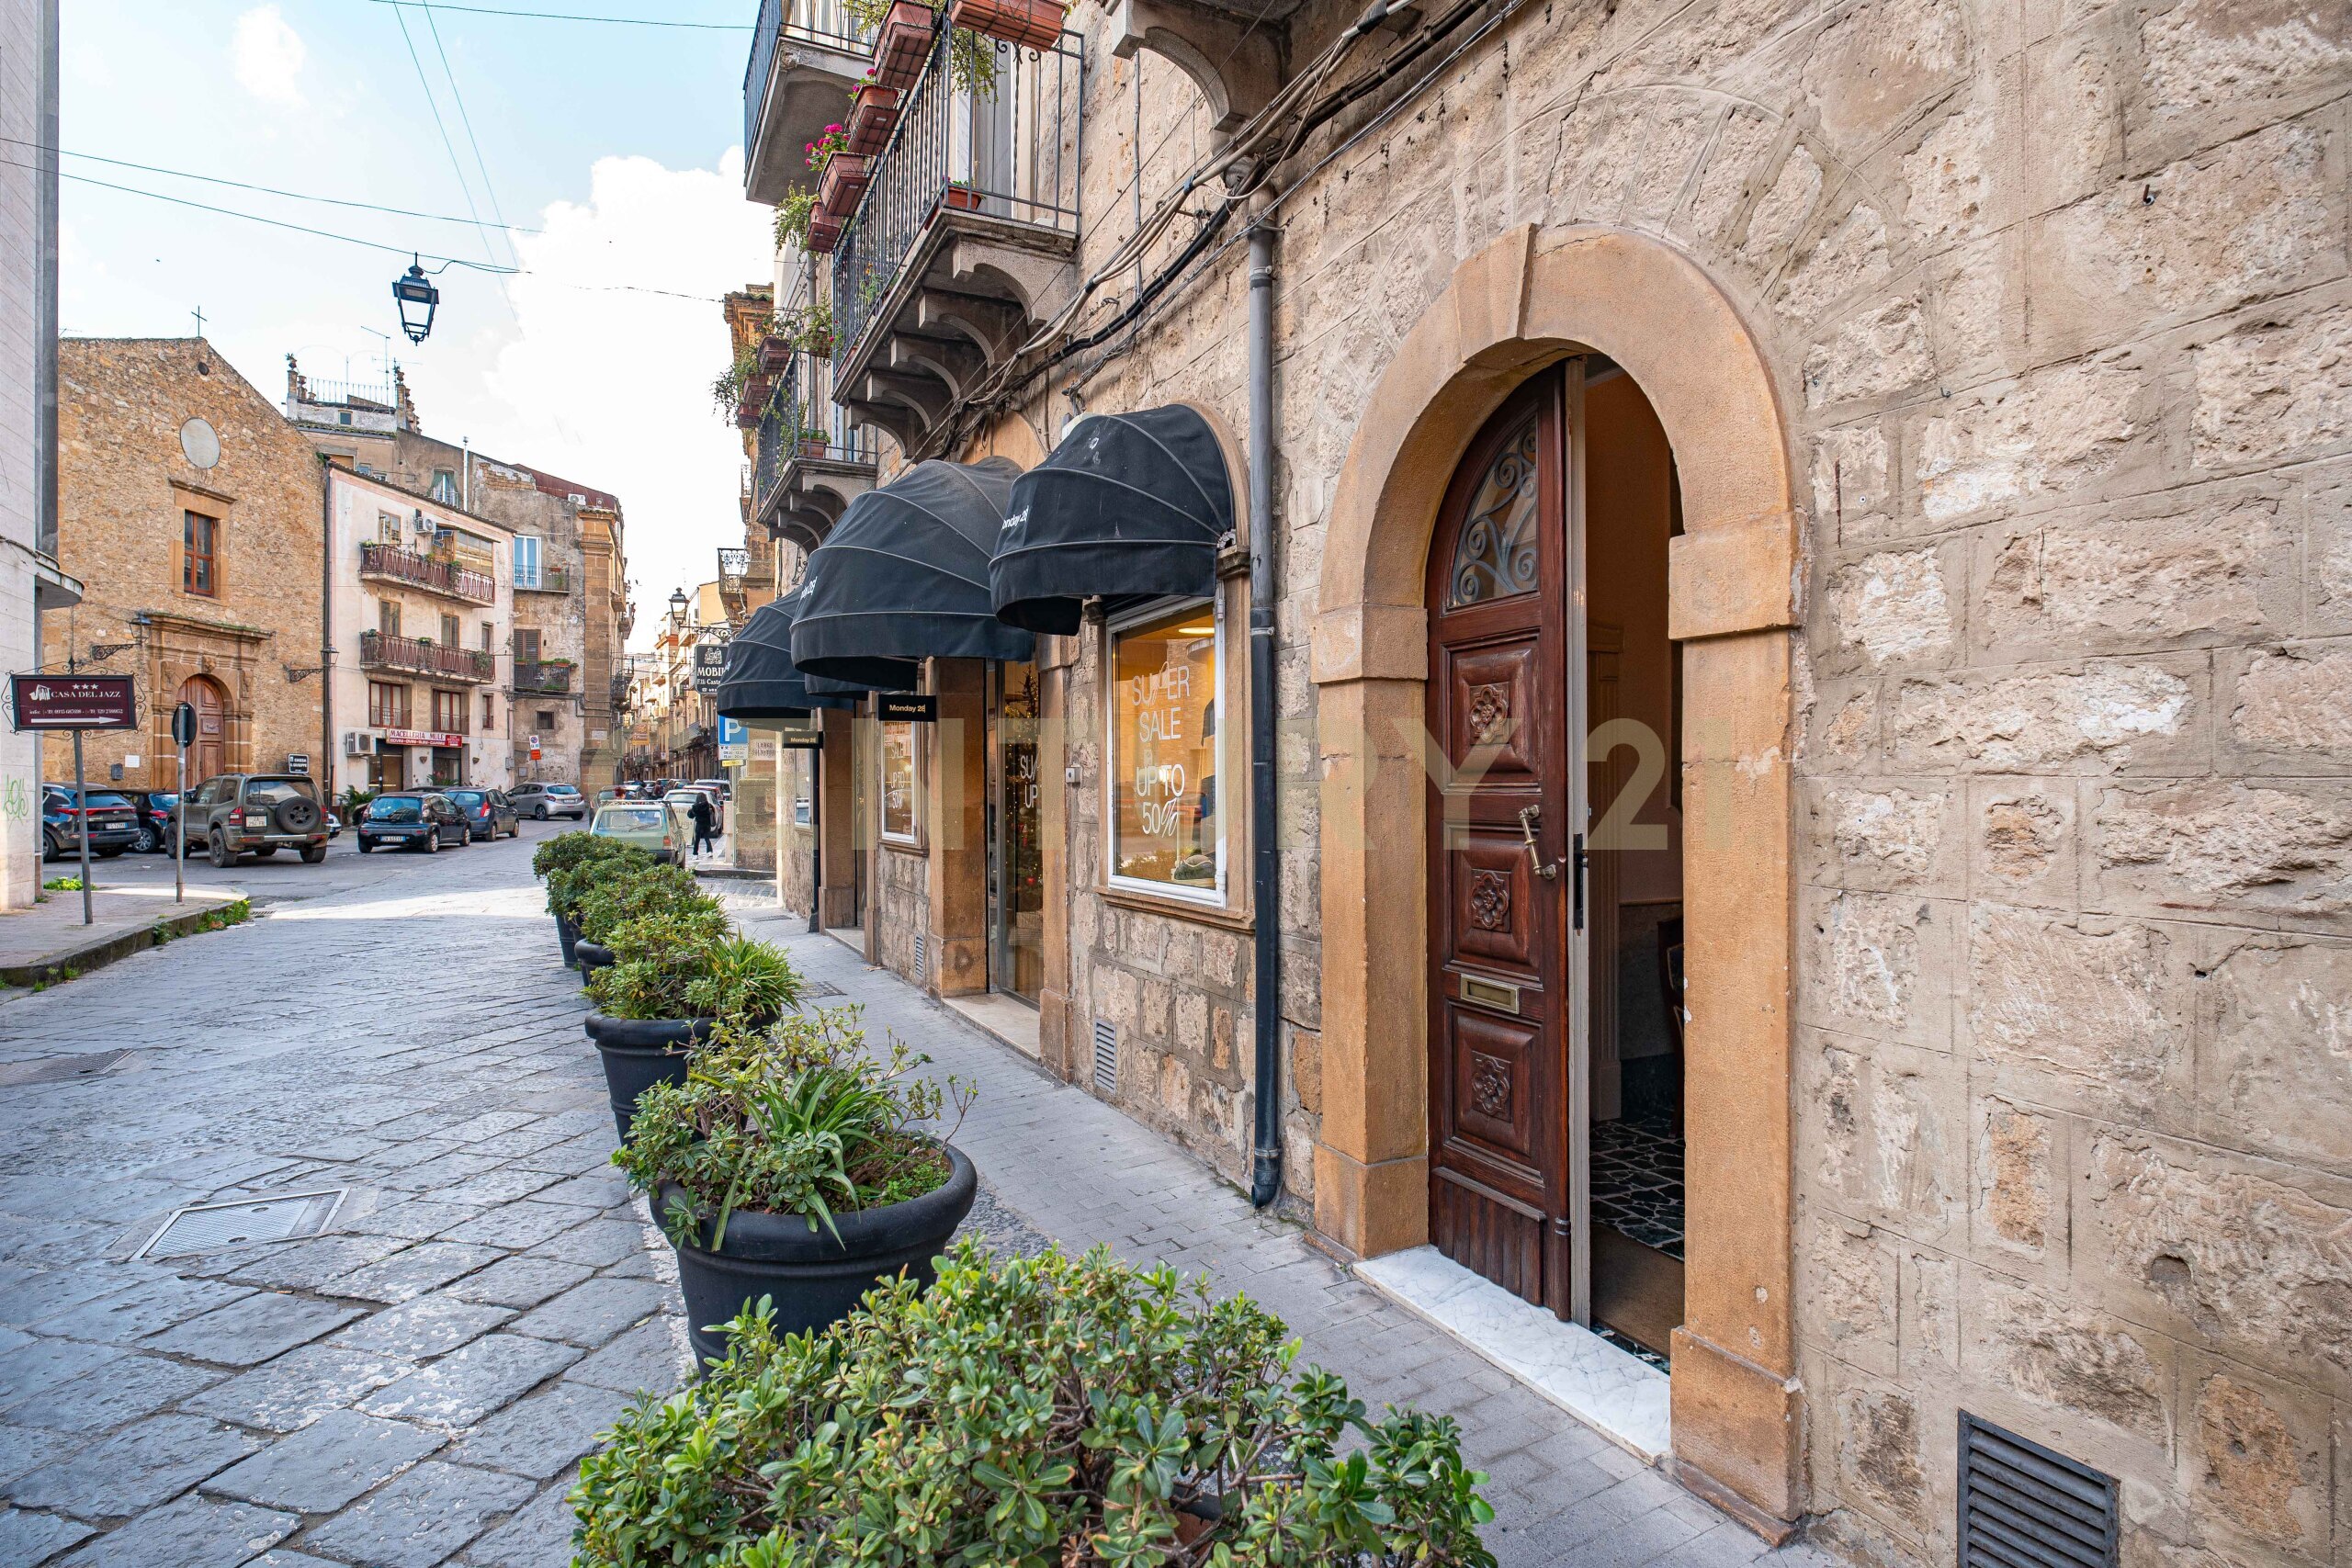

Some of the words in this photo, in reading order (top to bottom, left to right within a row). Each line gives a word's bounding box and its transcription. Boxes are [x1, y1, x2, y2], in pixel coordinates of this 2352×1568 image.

[1131, 660, 1191, 706] SUPER
[888, 704, 917, 713] Monday
[390, 730, 425, 739] MACELLERIA
[724, 717, 742, 742] P
[1139, 706, 1182, 743] SALE
[1136, 765, 1158, 797] UP
[1161, 763, 1185, 797] TO
[1024, 784, 1038, 808] UP
[1142, 797, 1179, 839] 50%
